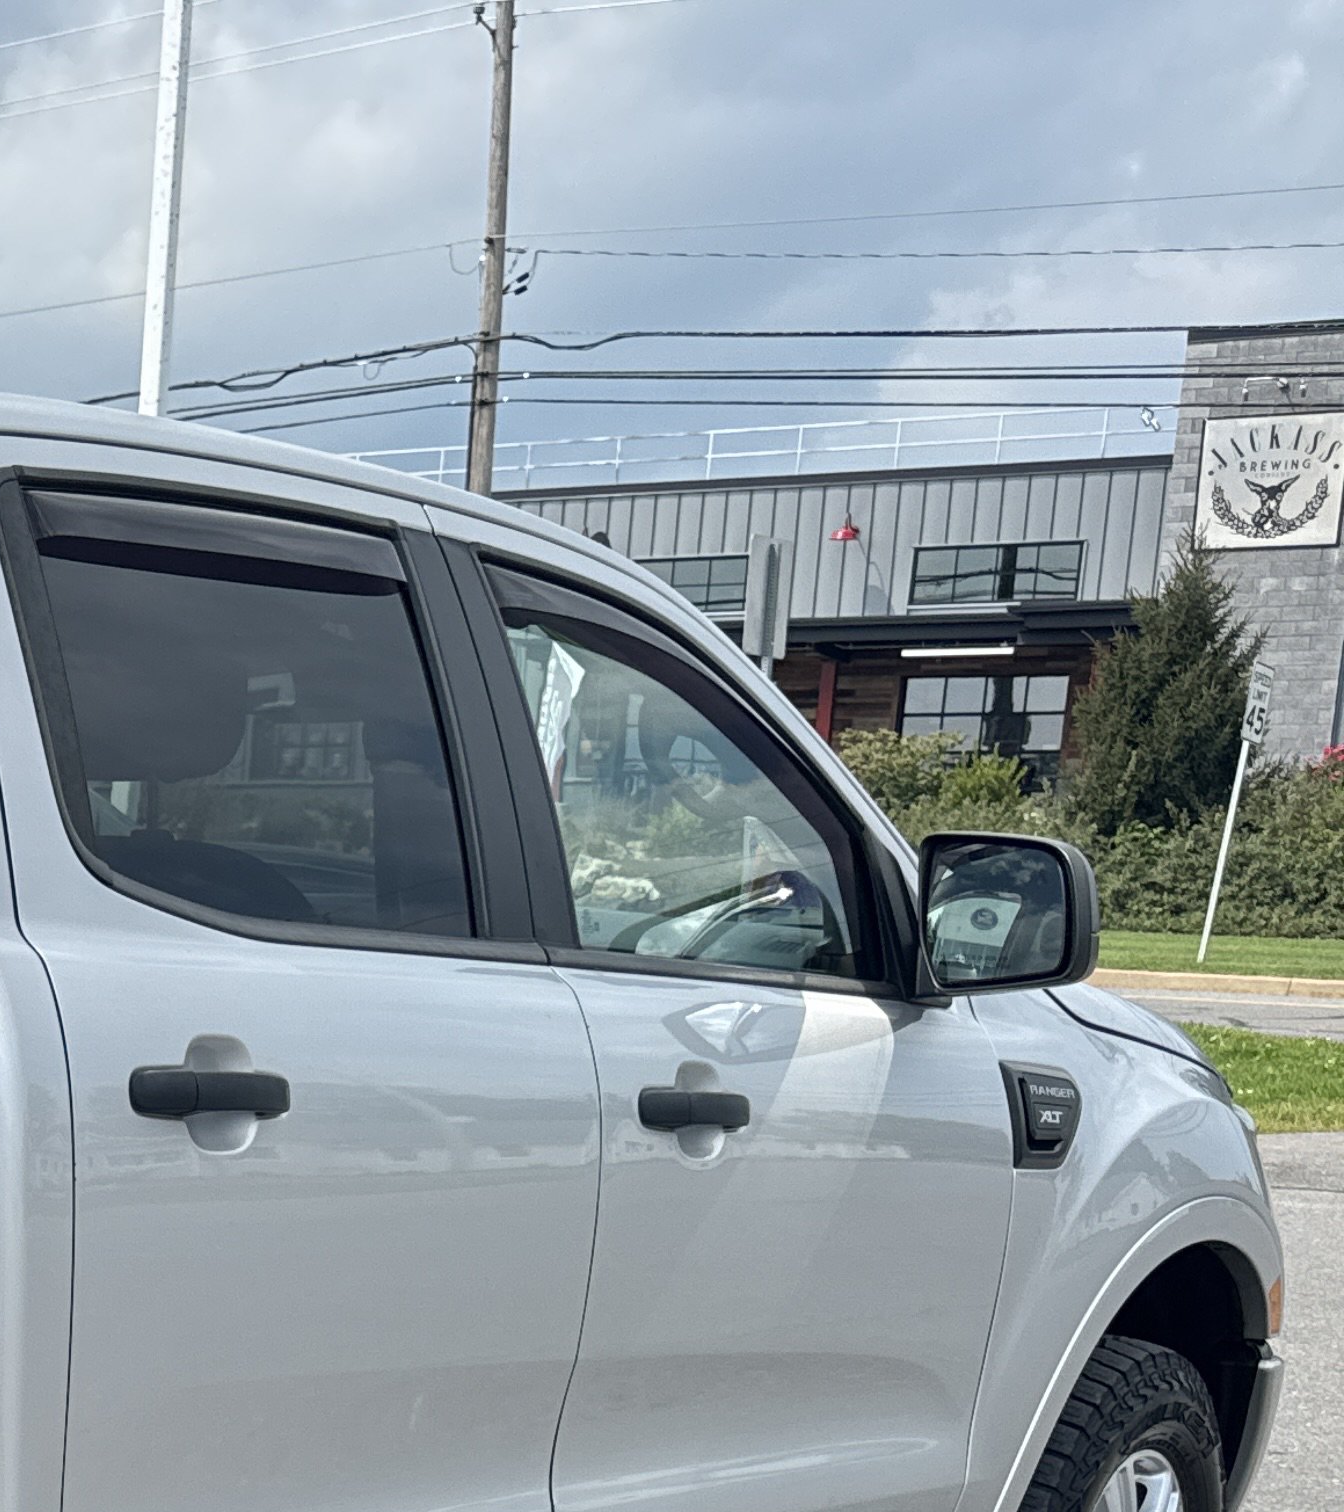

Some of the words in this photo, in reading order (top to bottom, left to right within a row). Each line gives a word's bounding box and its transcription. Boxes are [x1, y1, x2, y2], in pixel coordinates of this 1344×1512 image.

[1210, 424, 1343, 468] JACKASS
[1238, 458, 1312, 472] BREWING
[1246, 705, 1266, 735] 45
[1029, 1084, 1076, 1099] RANGER
[1039, 1110, 1064, 1124] XLT
